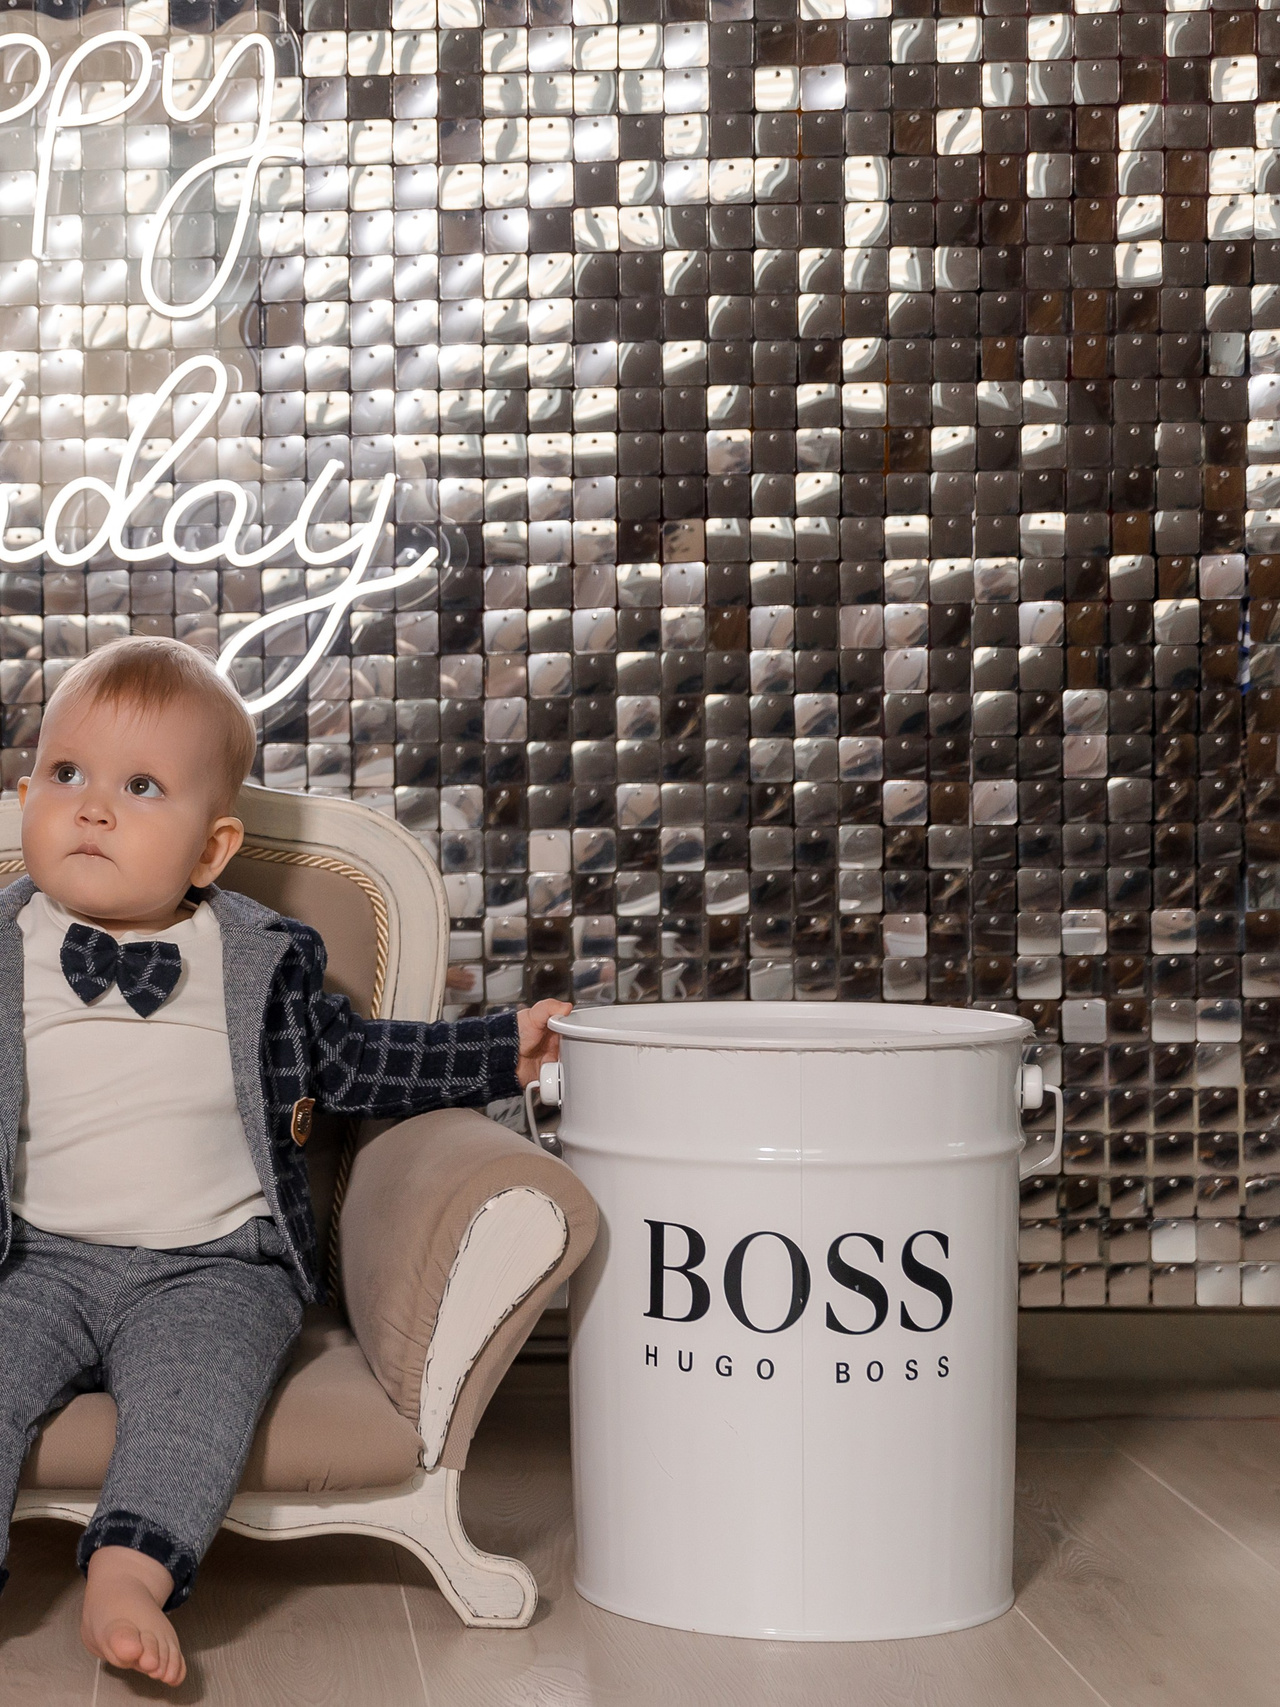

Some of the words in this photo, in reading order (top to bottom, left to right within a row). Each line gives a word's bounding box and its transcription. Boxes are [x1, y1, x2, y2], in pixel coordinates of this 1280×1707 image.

[642, 1218, 954, 1336] BOSS
[644, 1344, 775, 1381] HUGO
[835, 1355, 950, 1384] BOSS
